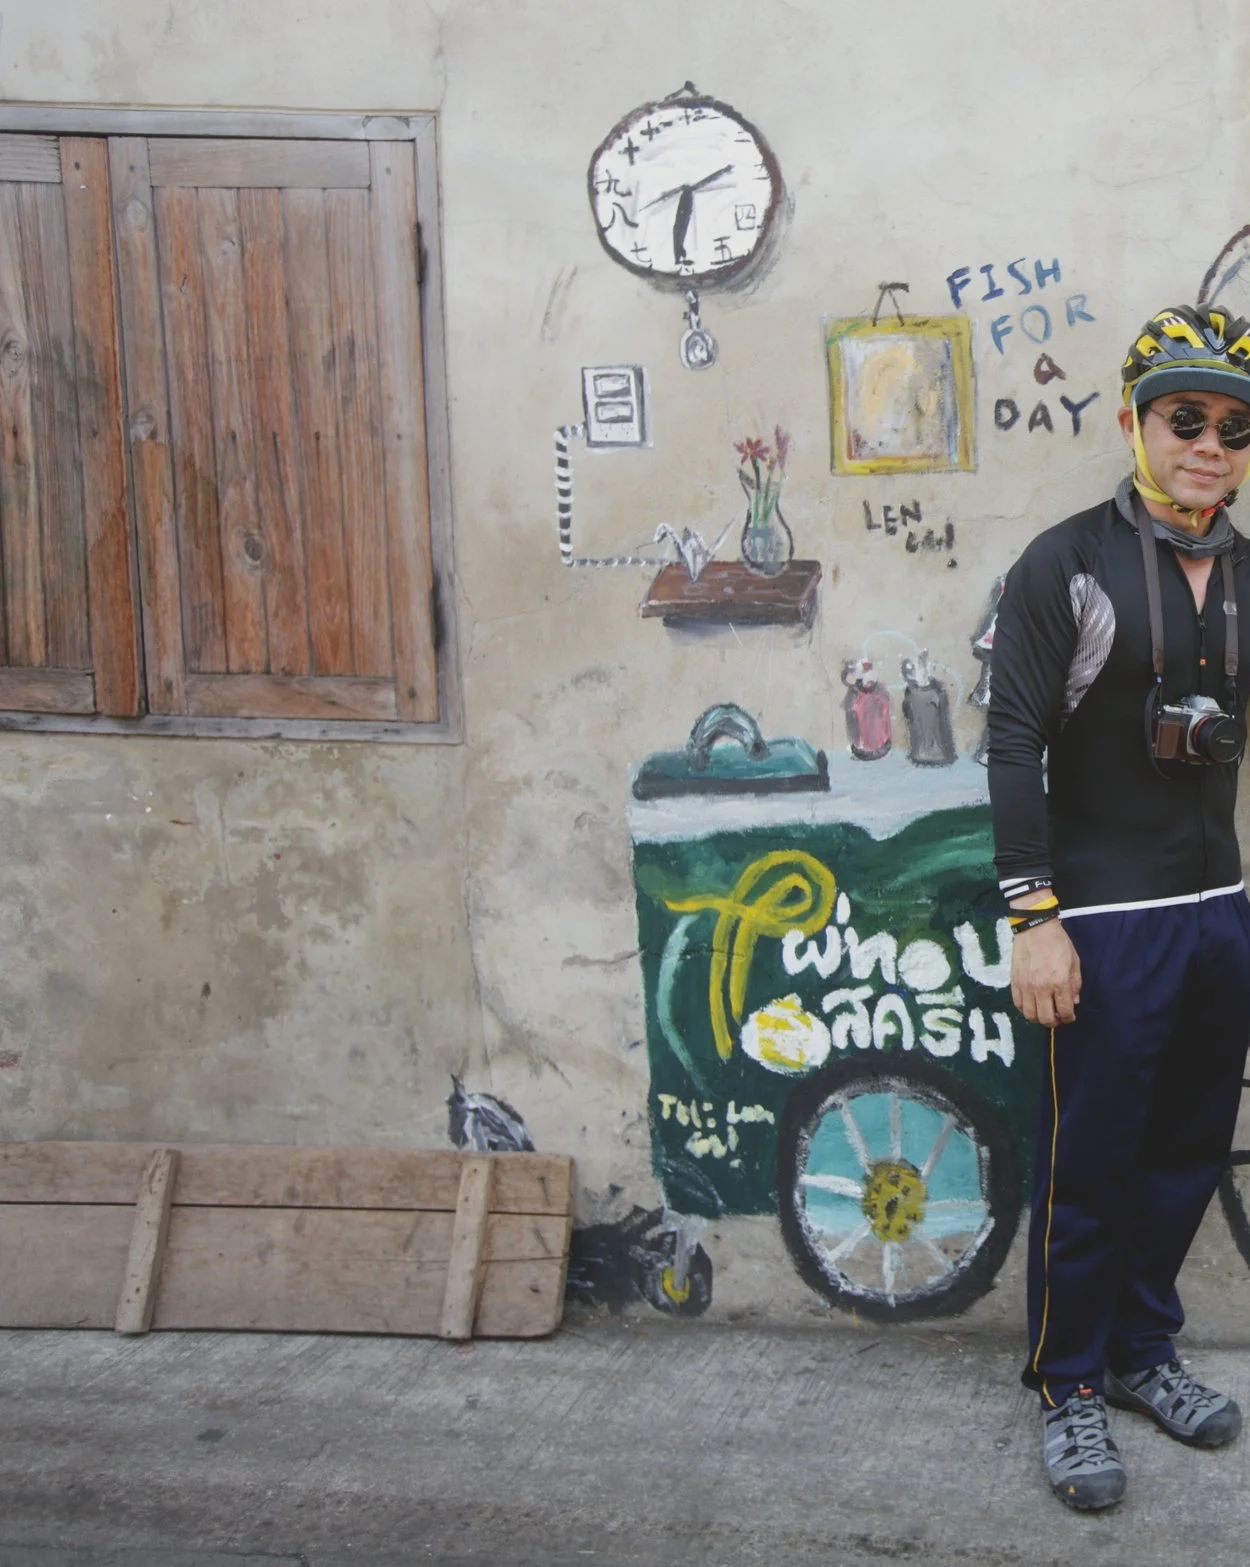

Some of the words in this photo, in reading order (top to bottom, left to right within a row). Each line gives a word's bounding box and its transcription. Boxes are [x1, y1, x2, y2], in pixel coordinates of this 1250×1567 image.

[946, 257, 1062, 309] FISH
[990, 294, 1096, 355] FOR
[1033, 352, 1067, 386] A
[994, 391, 1099, 437] DAY
[862, 498, 923, 536] LEN
